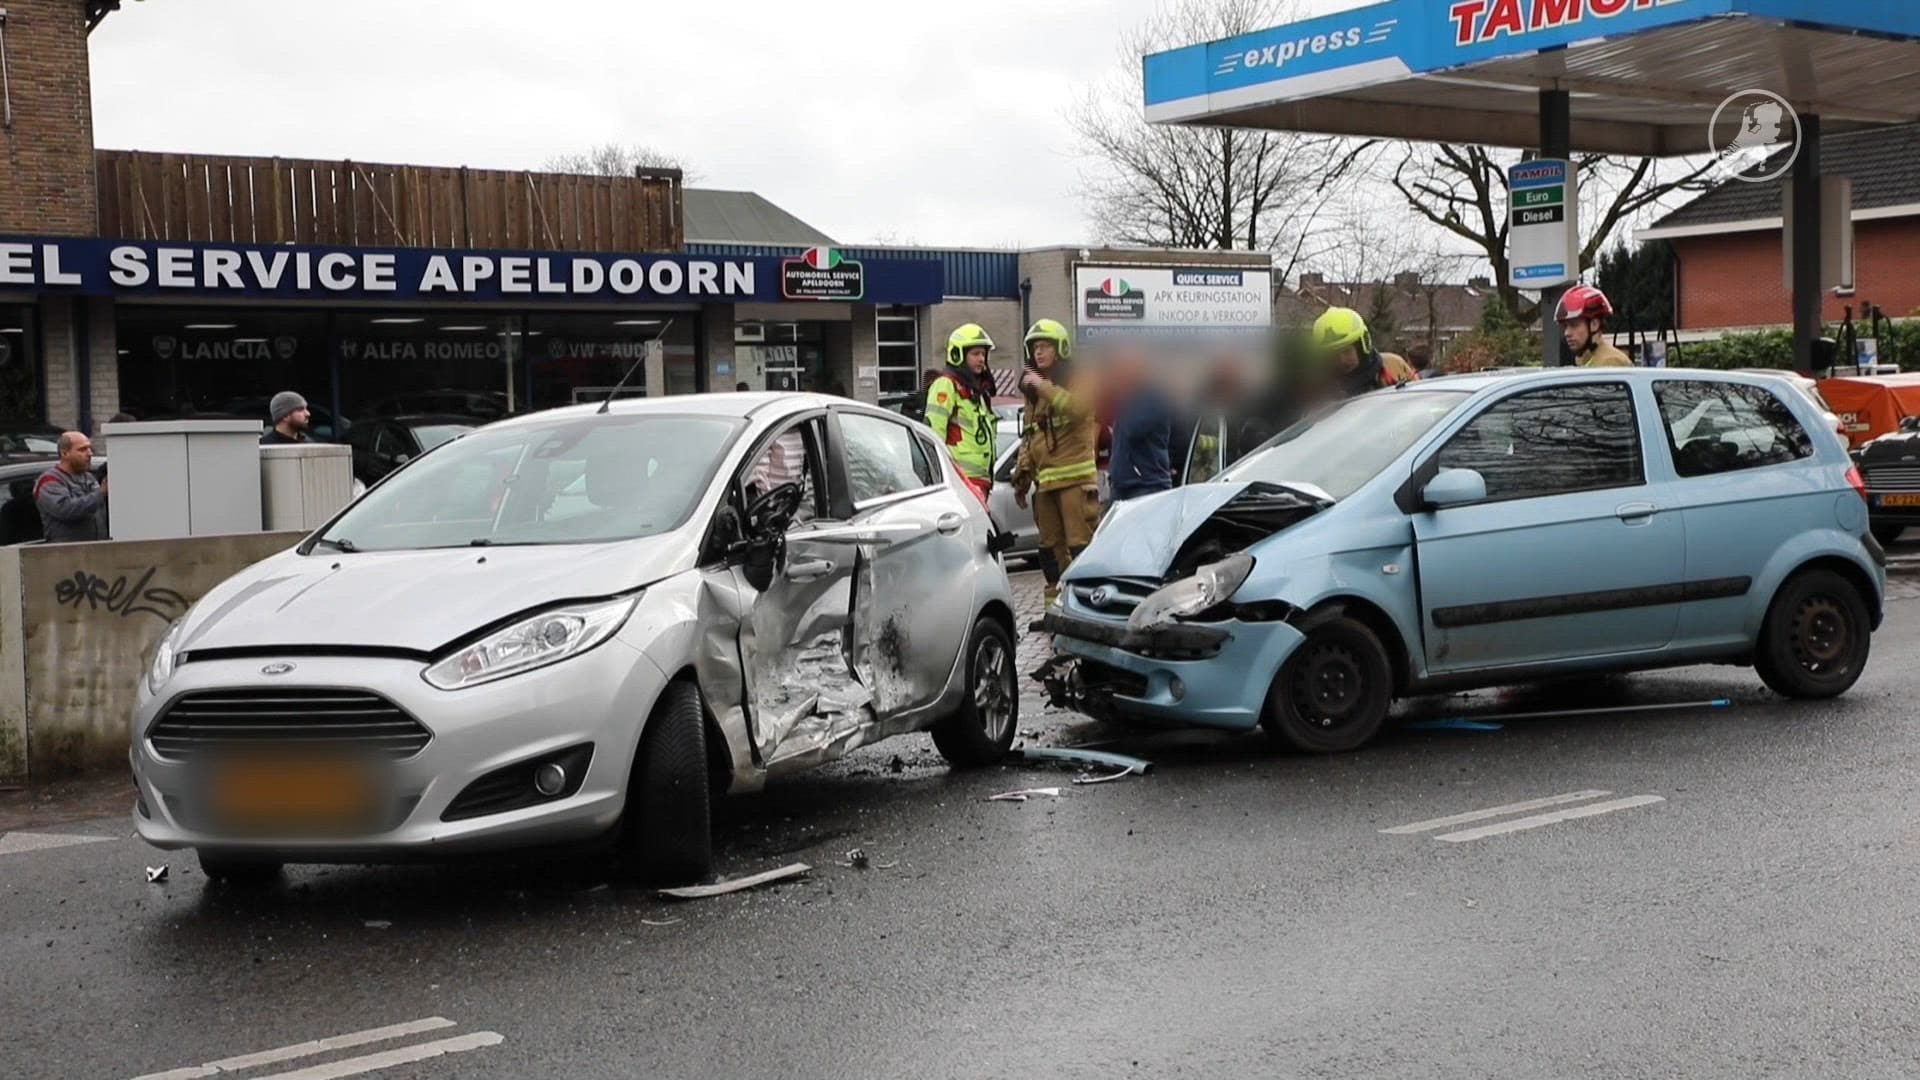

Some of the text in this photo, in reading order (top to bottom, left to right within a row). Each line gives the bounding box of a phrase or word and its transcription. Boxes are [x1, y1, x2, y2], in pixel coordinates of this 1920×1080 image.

[1450, 0, 1685, 46] TAM
[1244, 27, 1361, 67] express
[1515, 167, 1563, 180] TAMOIL
[1526, 191, 1549, 203] Euro
[1523, 209, 1553, 223] Diesel
[0, 243, 755, 295] EL SERVICE APELDOORN
[786, 271, 860, 280] AUTOMOBIEL SERVICE
[1176, 274, 1240, 285] QUICK SERVICE
[1154, 291, 1262, 303] APK KEURINGSTATION
[1158, 310, 1258, 321] INKOOP & VERKOOP
[181, 341, 272, 359] LANCIA
[363, 342, 501, 359] ALFA ROMEO
[569, 343, 595, 358] VW
